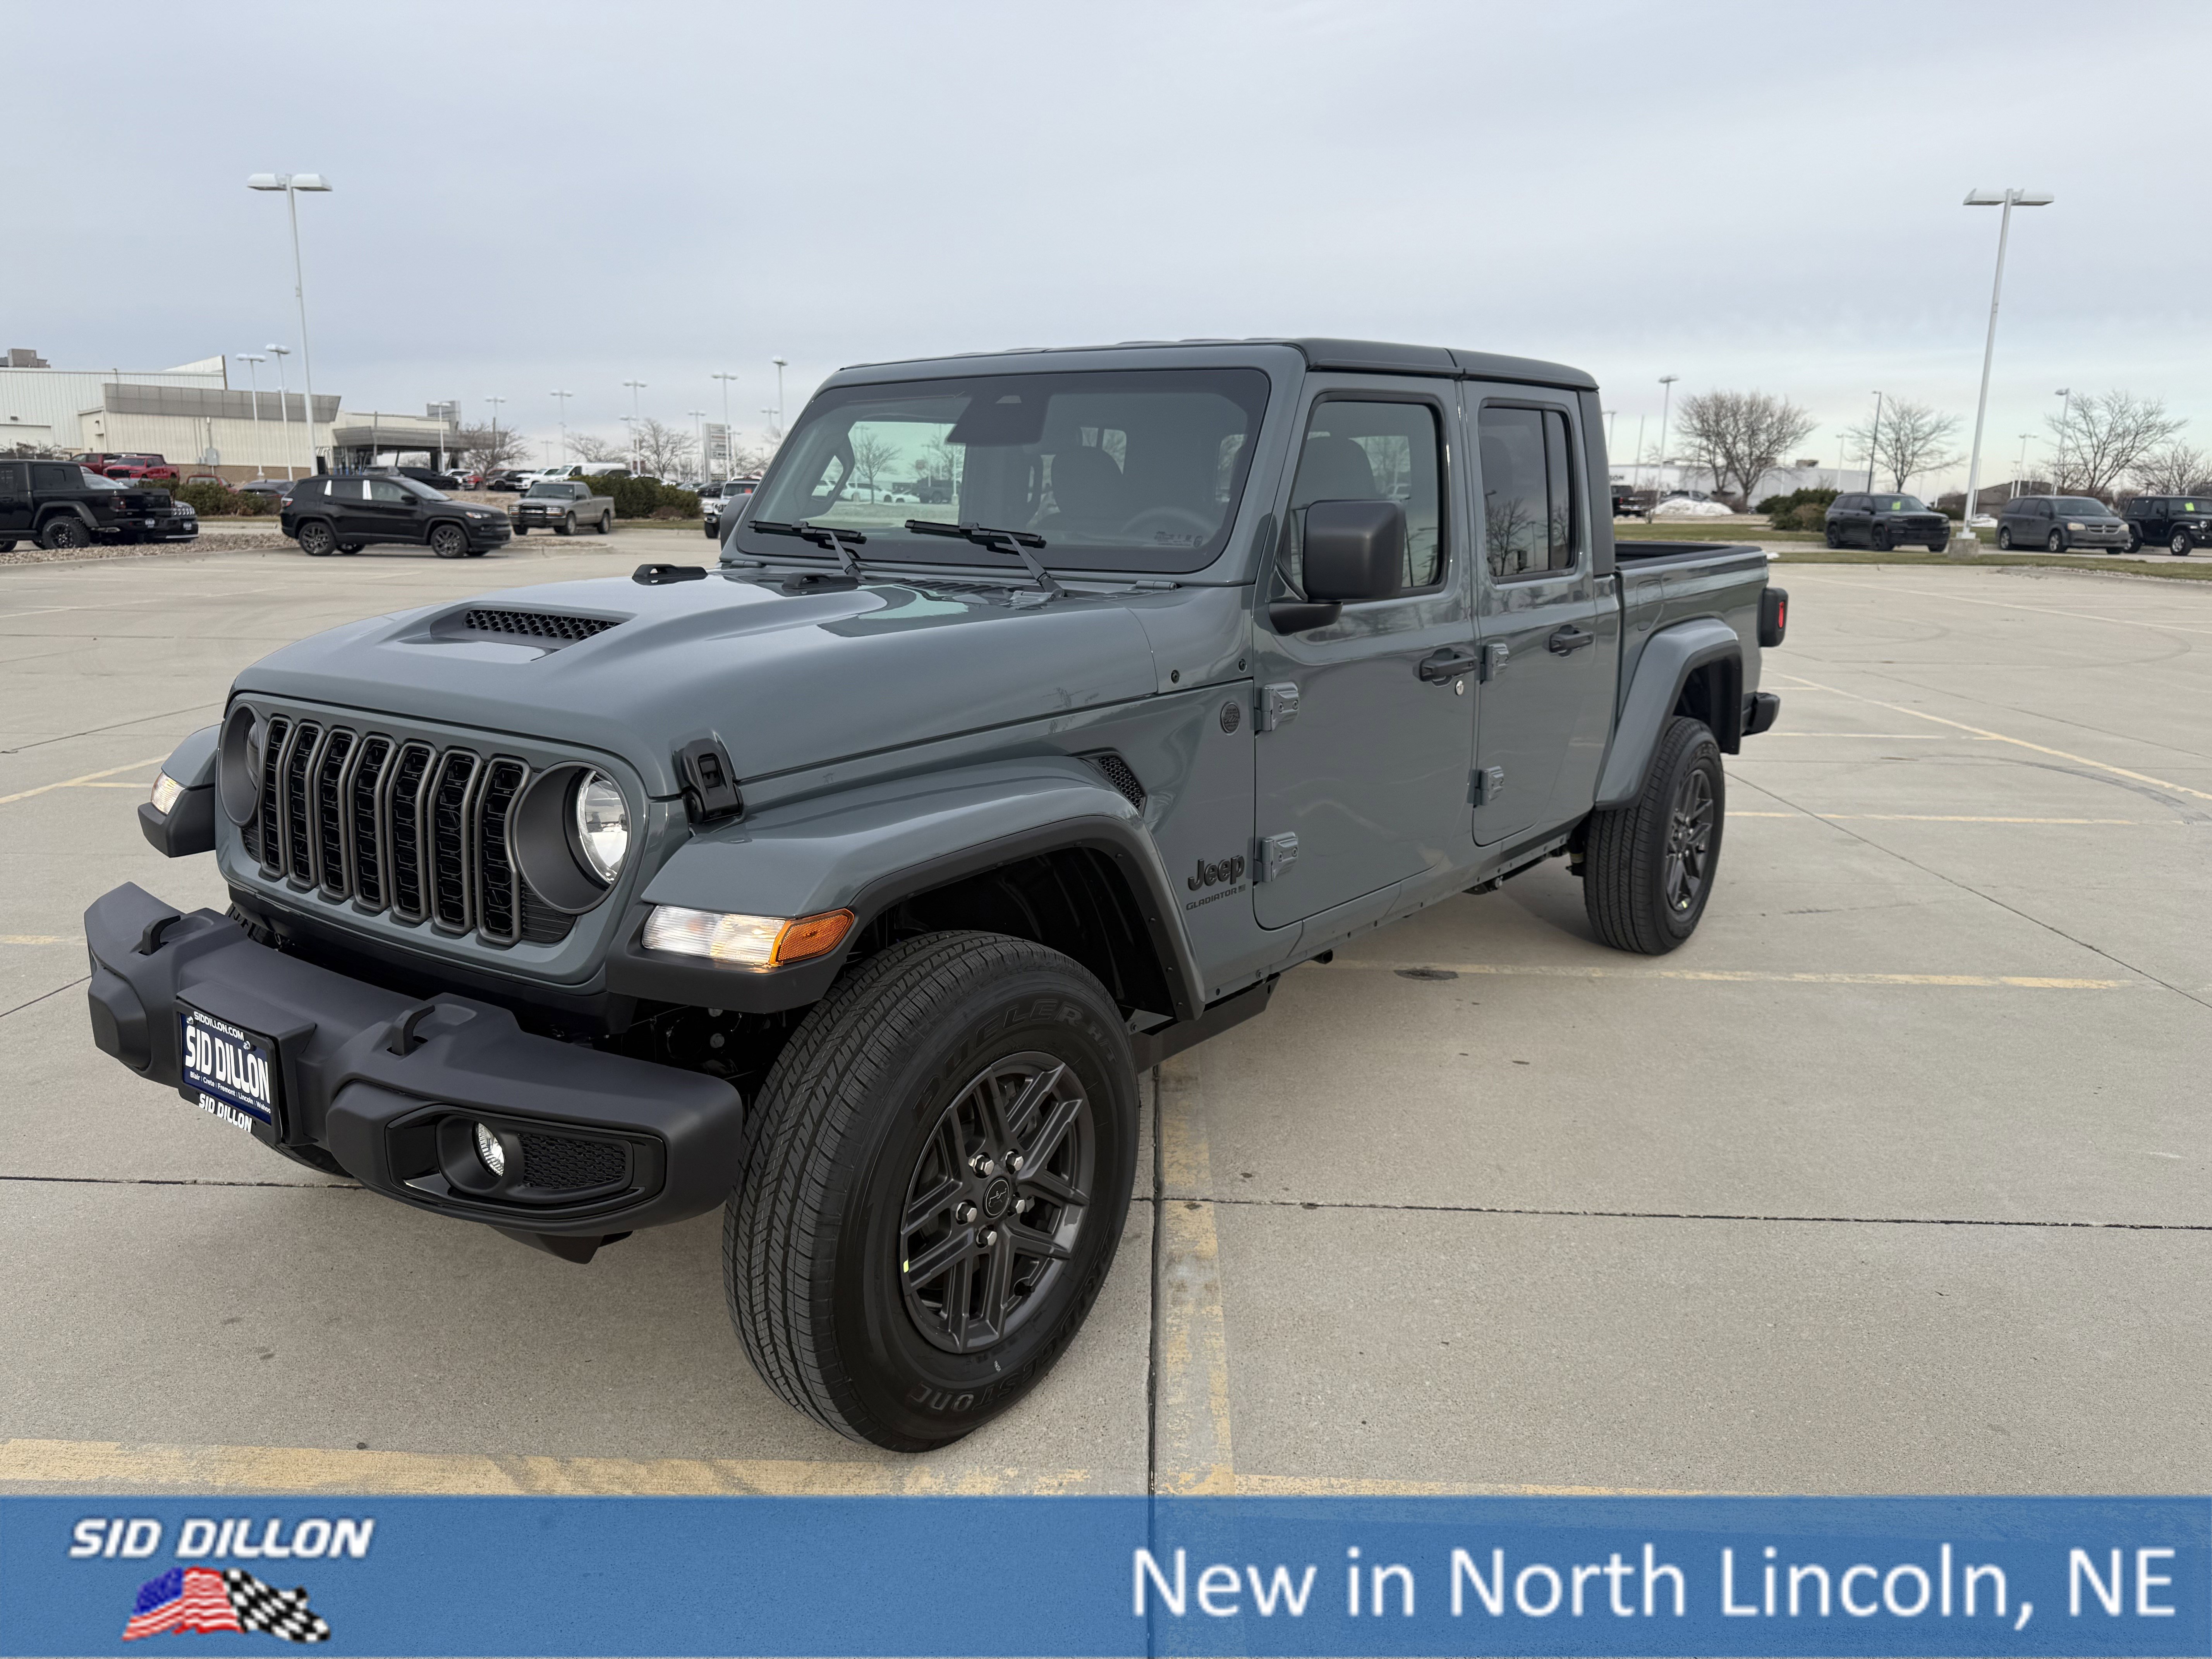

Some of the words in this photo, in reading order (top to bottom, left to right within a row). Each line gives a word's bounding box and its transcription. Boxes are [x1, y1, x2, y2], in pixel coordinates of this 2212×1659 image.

[1188, 855, 1245, 891] Jeep
[1186, 887, 1237, 910] GLADIATOR
[194, 1011, 244, 1041] SIDDILLON.COM
[185, 1025, 212, 1075] SID
[215, 1037, 270, 1104] DILLON
[912, 998, 1084, 1128] DUELER
[190, 1071, 200, 1080] Blair
[203, 1077, 215, 1087] Crete
[218, 1083, 235, 1096] Fremont
[239, 1092, 253, 1105] Lincoln
[256, 1101, 271, 1113] Wahoo
[199, 1093, 215, 1113] SID
[217, 1102, 252, 1133] DILLON
